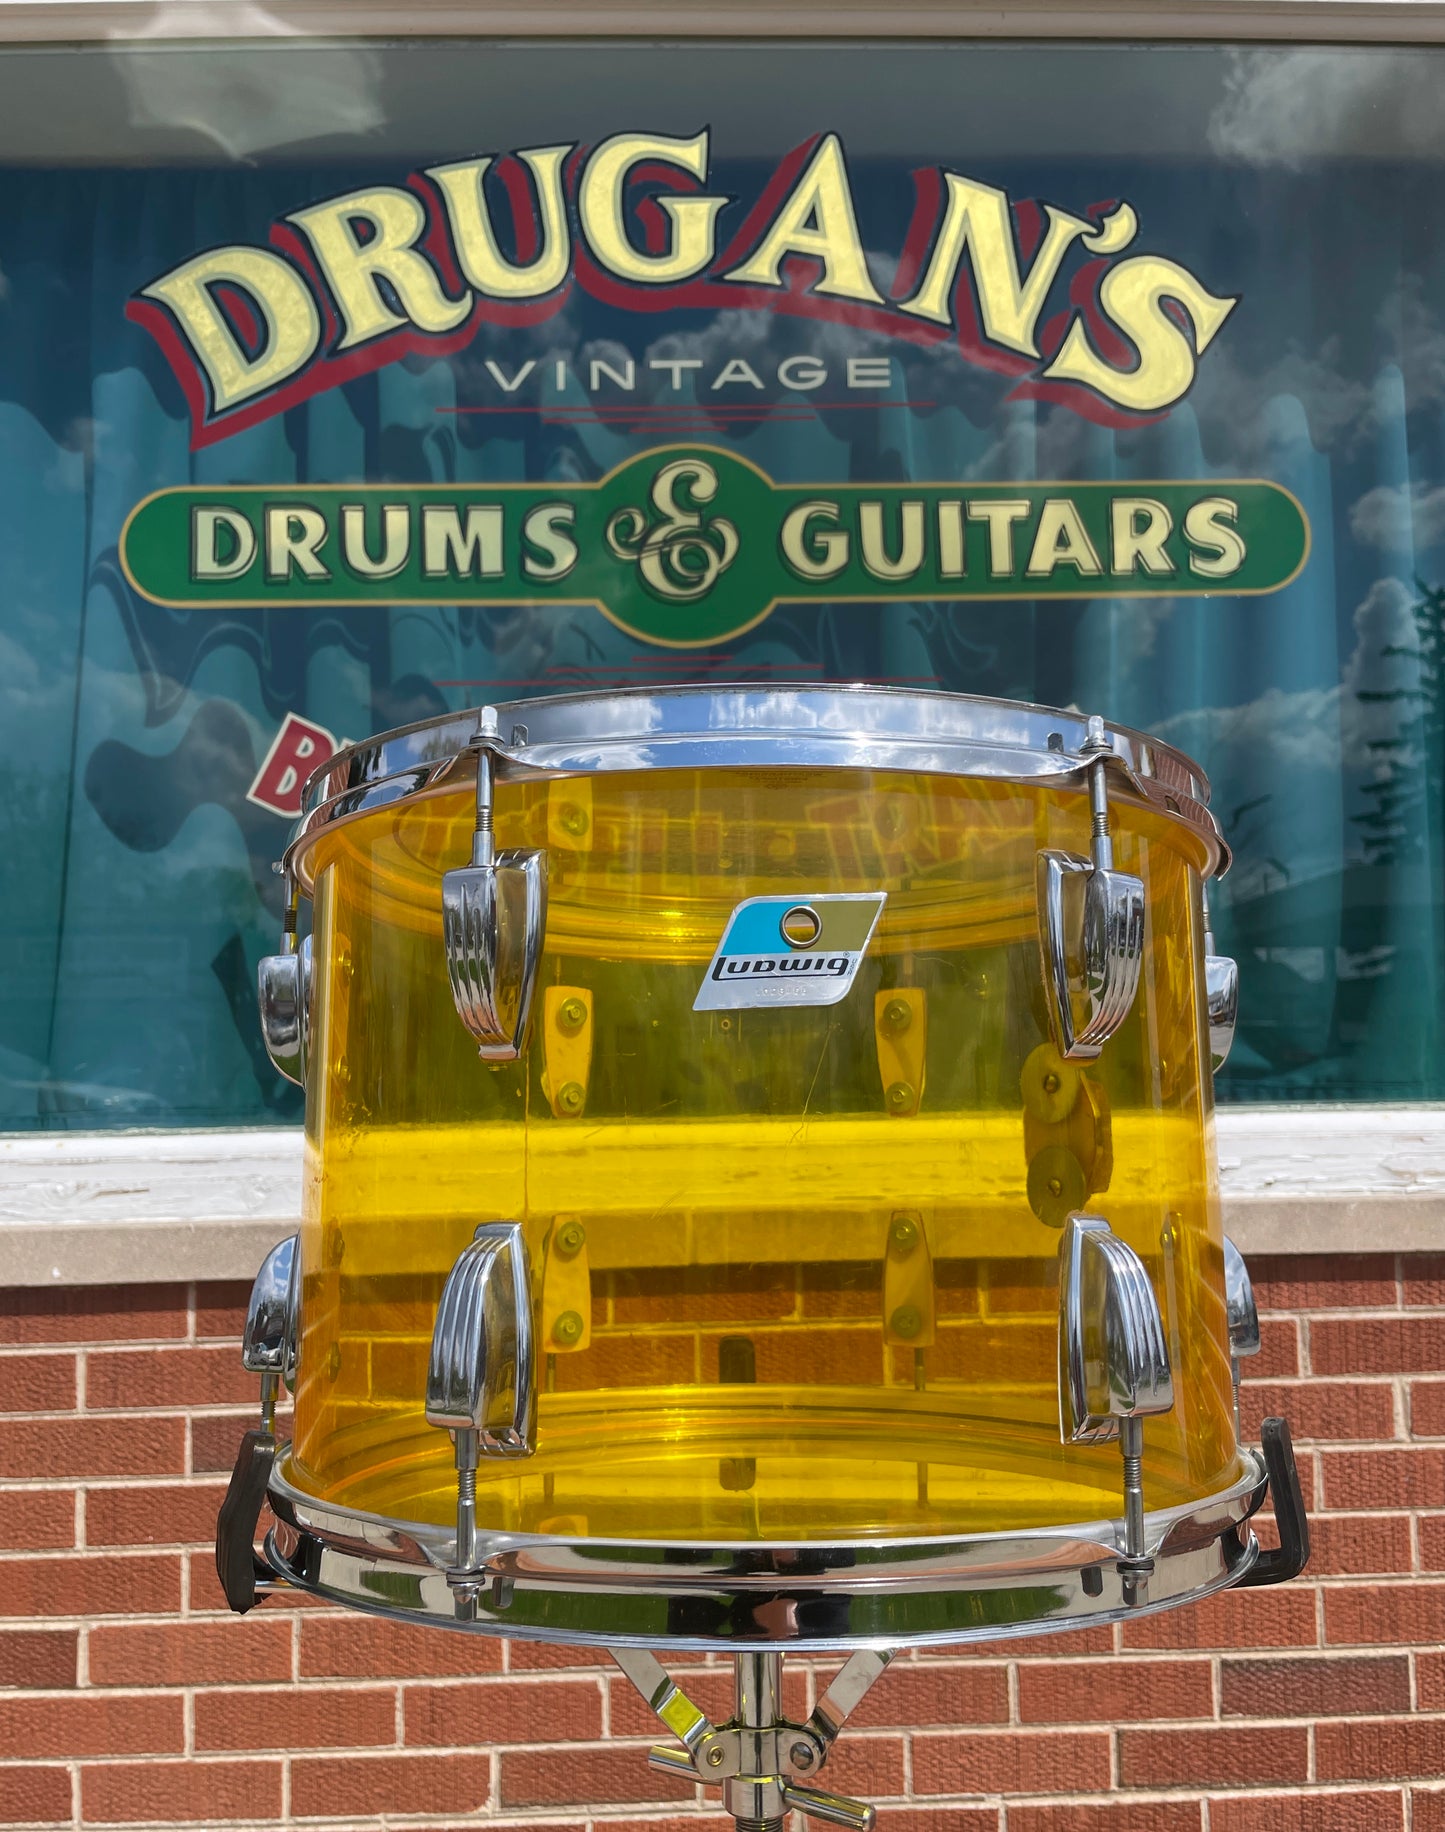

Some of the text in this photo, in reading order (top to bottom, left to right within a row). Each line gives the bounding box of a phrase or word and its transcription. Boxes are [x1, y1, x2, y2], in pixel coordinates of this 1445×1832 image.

[130, 124, 1242, 430] DRUGAN'S
[485, 356, 891, 391] VINTAGE
[189, 457, 1247, 601] DRUMS & GUITARS
